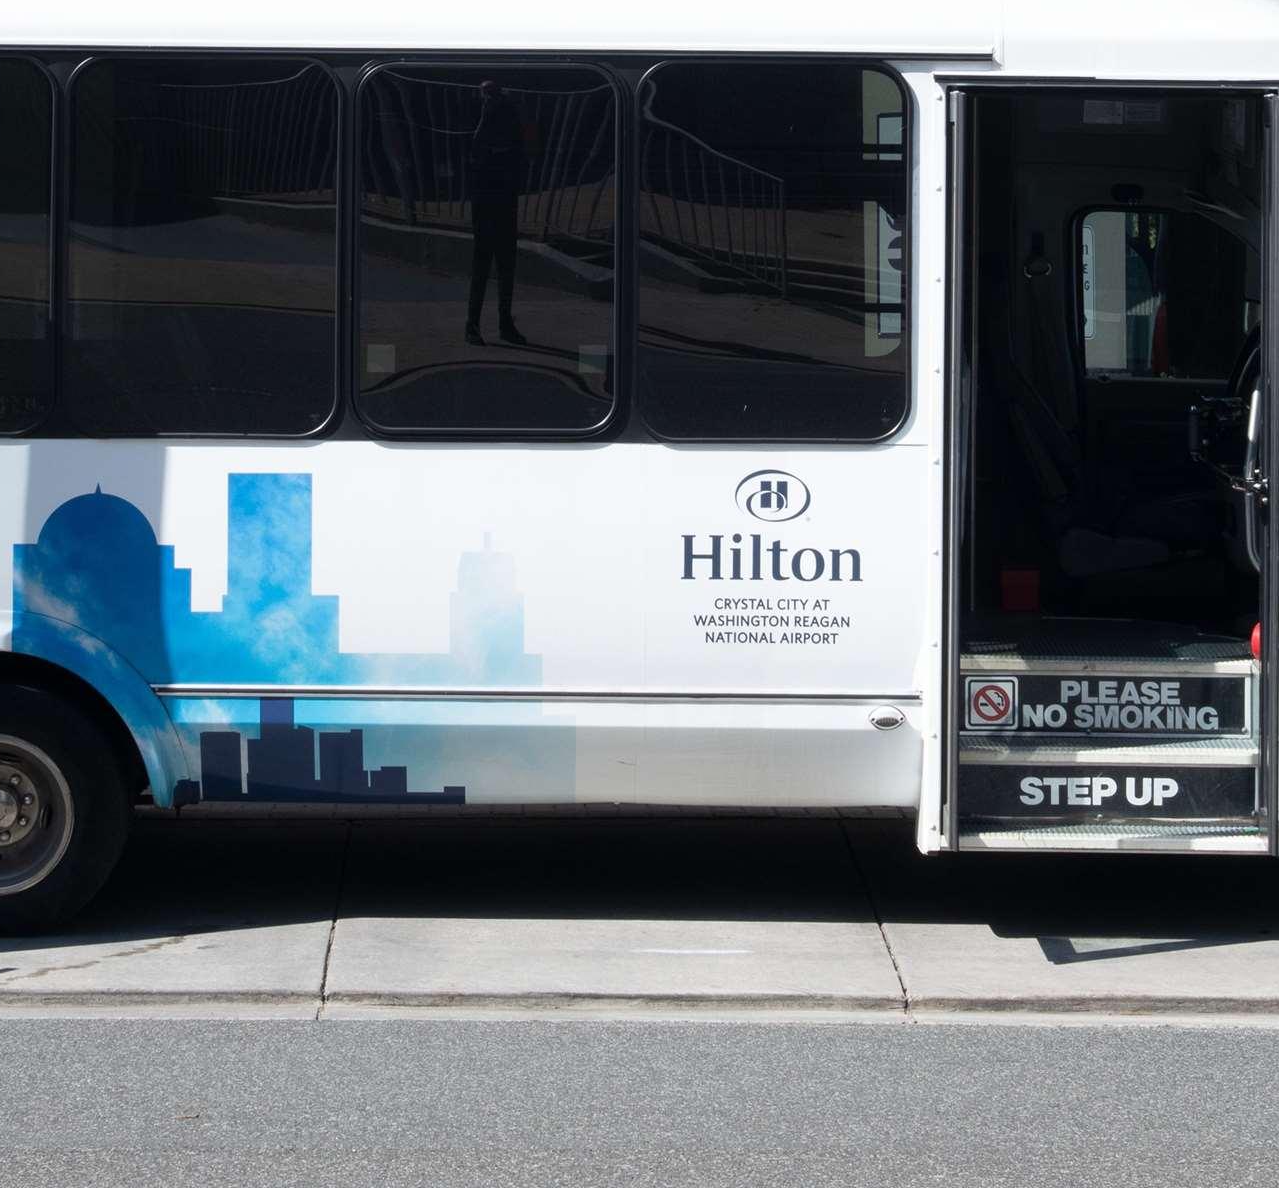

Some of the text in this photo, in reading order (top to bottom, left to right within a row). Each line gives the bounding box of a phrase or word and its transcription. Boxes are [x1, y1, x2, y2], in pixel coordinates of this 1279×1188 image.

[681, 533, 864, 582] Hilton
[714, 598, 830, 610] CRYSTAL CITY AT
[694, 615, 850, 628] WASHINGTON REAGAN
[705, 632, 838, 644] NATIONAL AIRPORT
[1061, 680, 1180, 704] PLEASE
[1022, 703, 1219, 730] NO SMOKING
[1019, 776, 1179, 806] STEP UP
